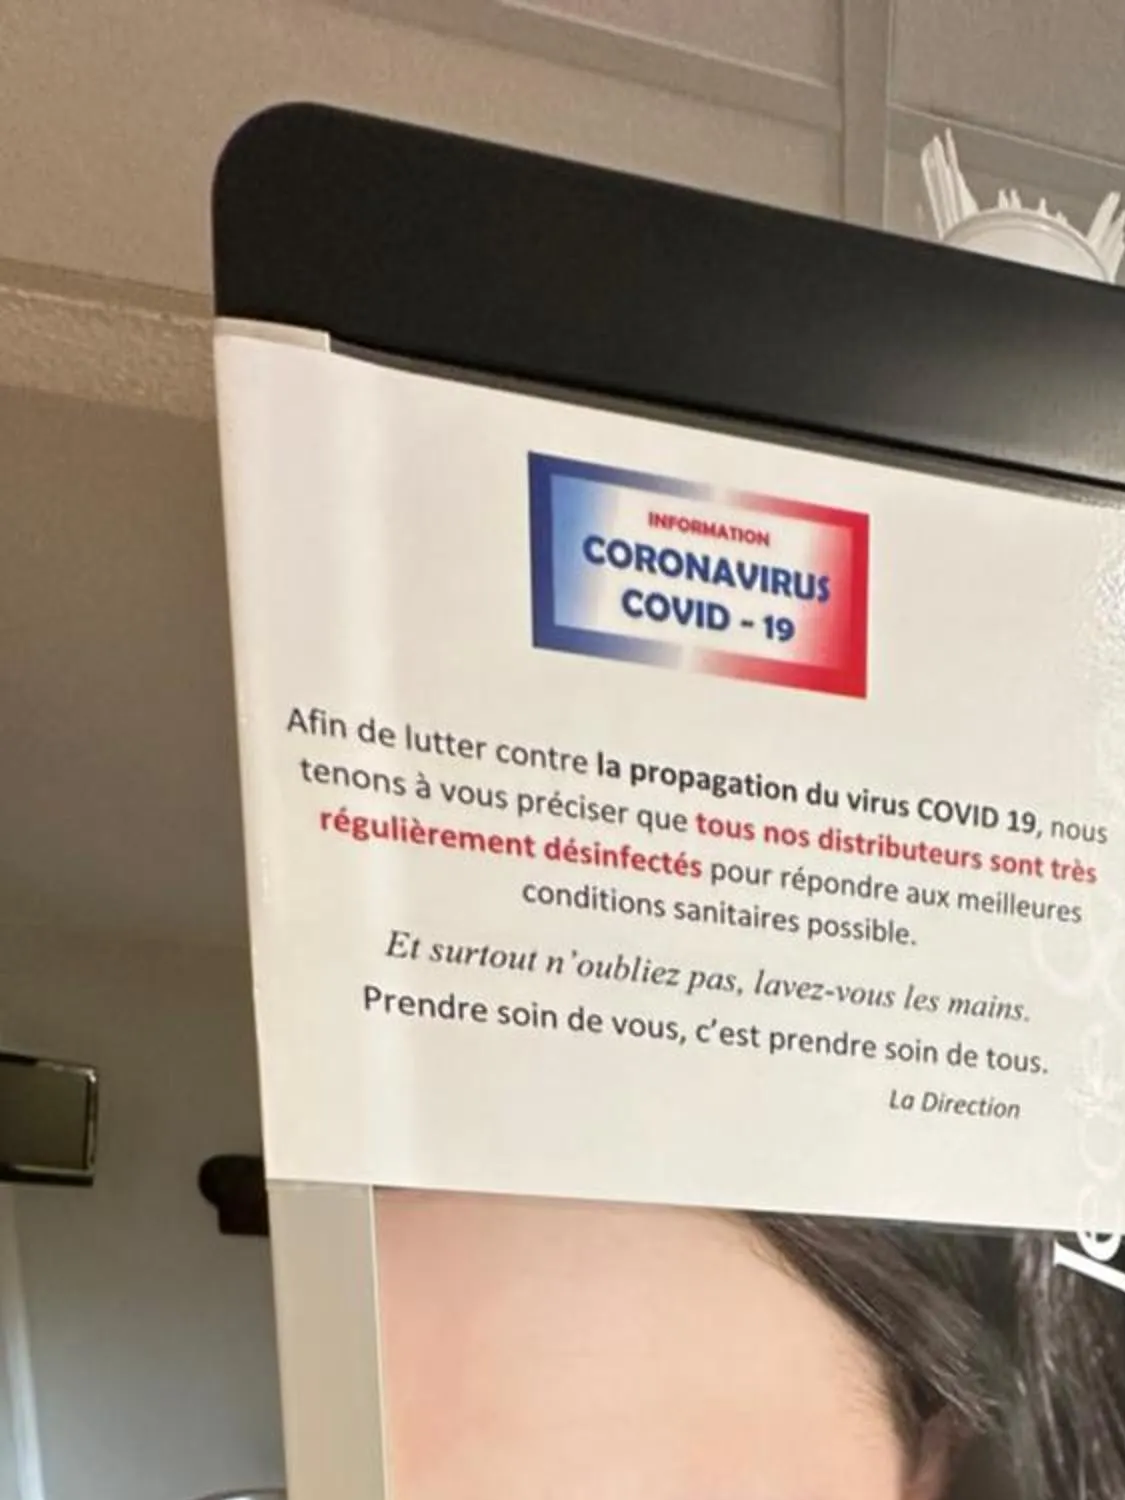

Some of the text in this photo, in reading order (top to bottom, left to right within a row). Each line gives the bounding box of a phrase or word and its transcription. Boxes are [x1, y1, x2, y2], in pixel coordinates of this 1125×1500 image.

[582, 534, 830, 602] CORONAVIRUS
[648, 511, 769, 547] INFORMATION
[621, 588, 731, 631] COVID
[764, 614, 795, 642] 19
[287, 707, 1108, 845] Afin de lutter contre la propagation du virus COVID 19, nous
[300, 758, 1098, 884] tenons à vous préciser que tous nos distributeurs sont très
[320, 806, 1082, 924] régulièrement désinfectés pour répondre aux meilleures
[522, 881, 918, 946] conditions sanitaires possible.
[385, 929, 1031, 1023] Et surtout n’oubliez pas, lavez-vous les mains.
[363, 984, 1049, 1076] Prendre soin de vous, c’est prendre soin de tous.
[889, 1089, 1021, 1120] La Direction
